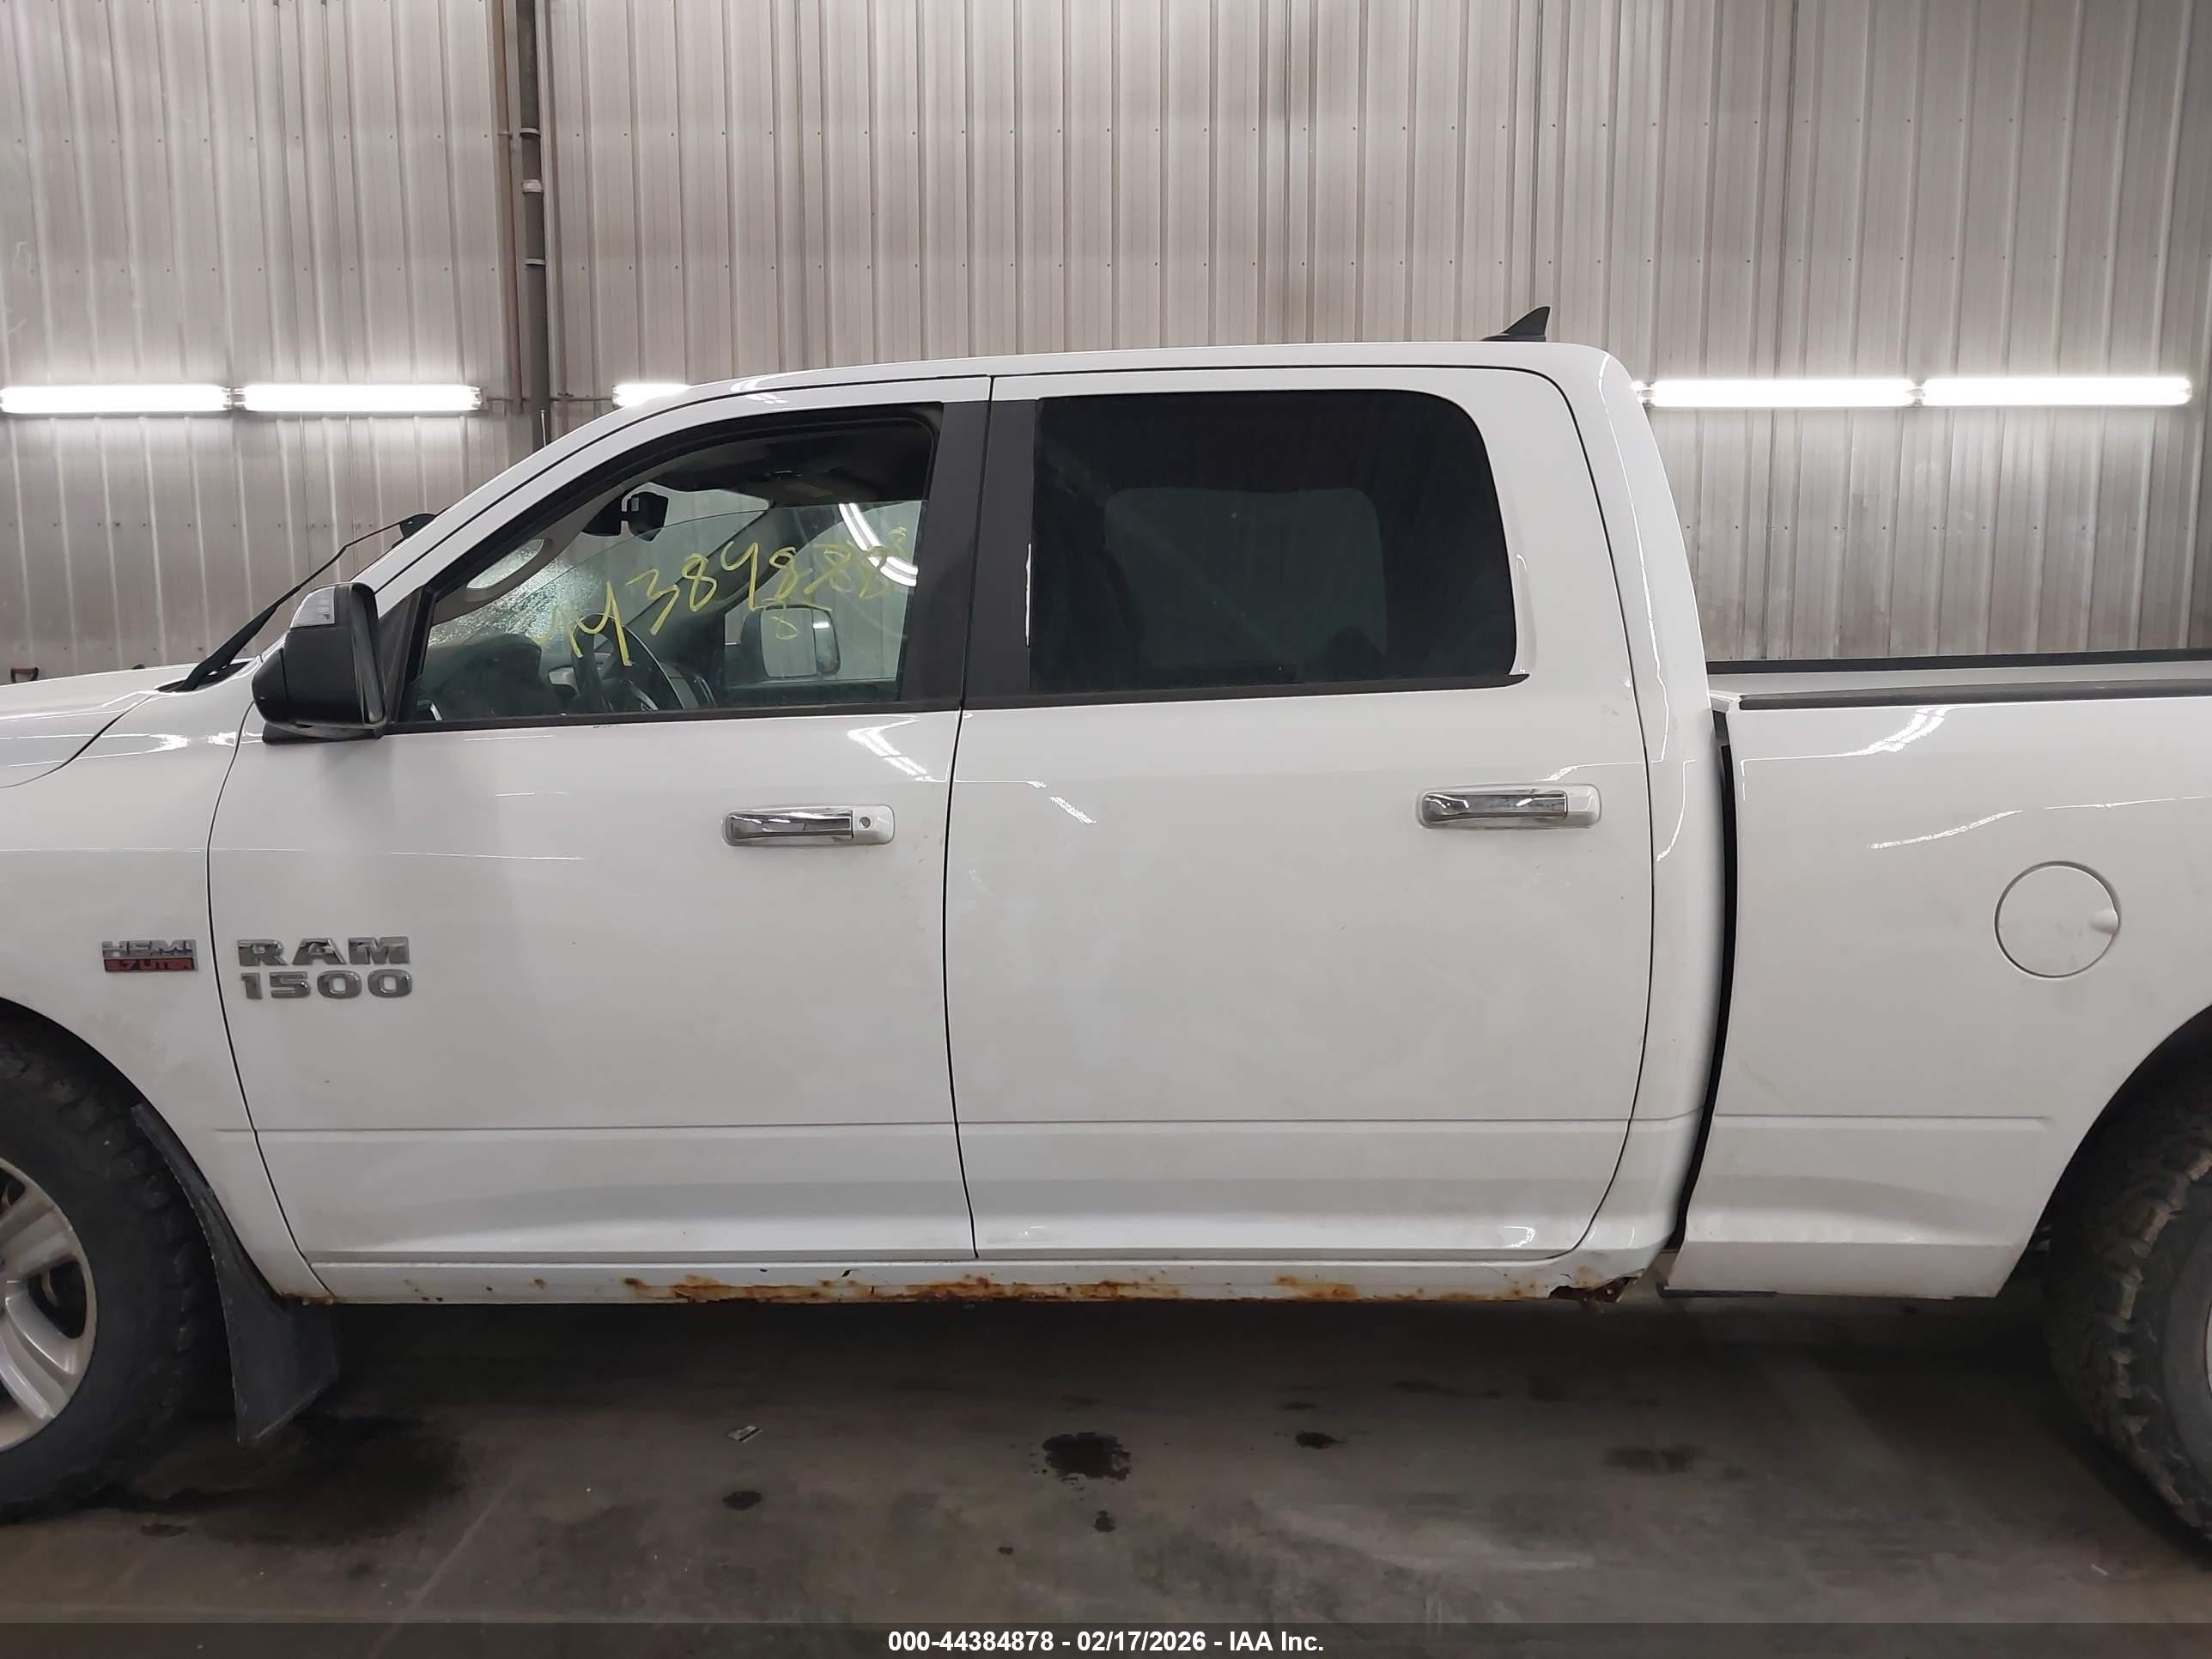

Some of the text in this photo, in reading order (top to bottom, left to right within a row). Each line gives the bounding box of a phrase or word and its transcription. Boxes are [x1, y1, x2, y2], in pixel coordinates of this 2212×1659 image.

[102, 939, 197, 958] HEMI
[237, 937, 409, 966] RAM
[240, 969, 412, 1000] 1500
